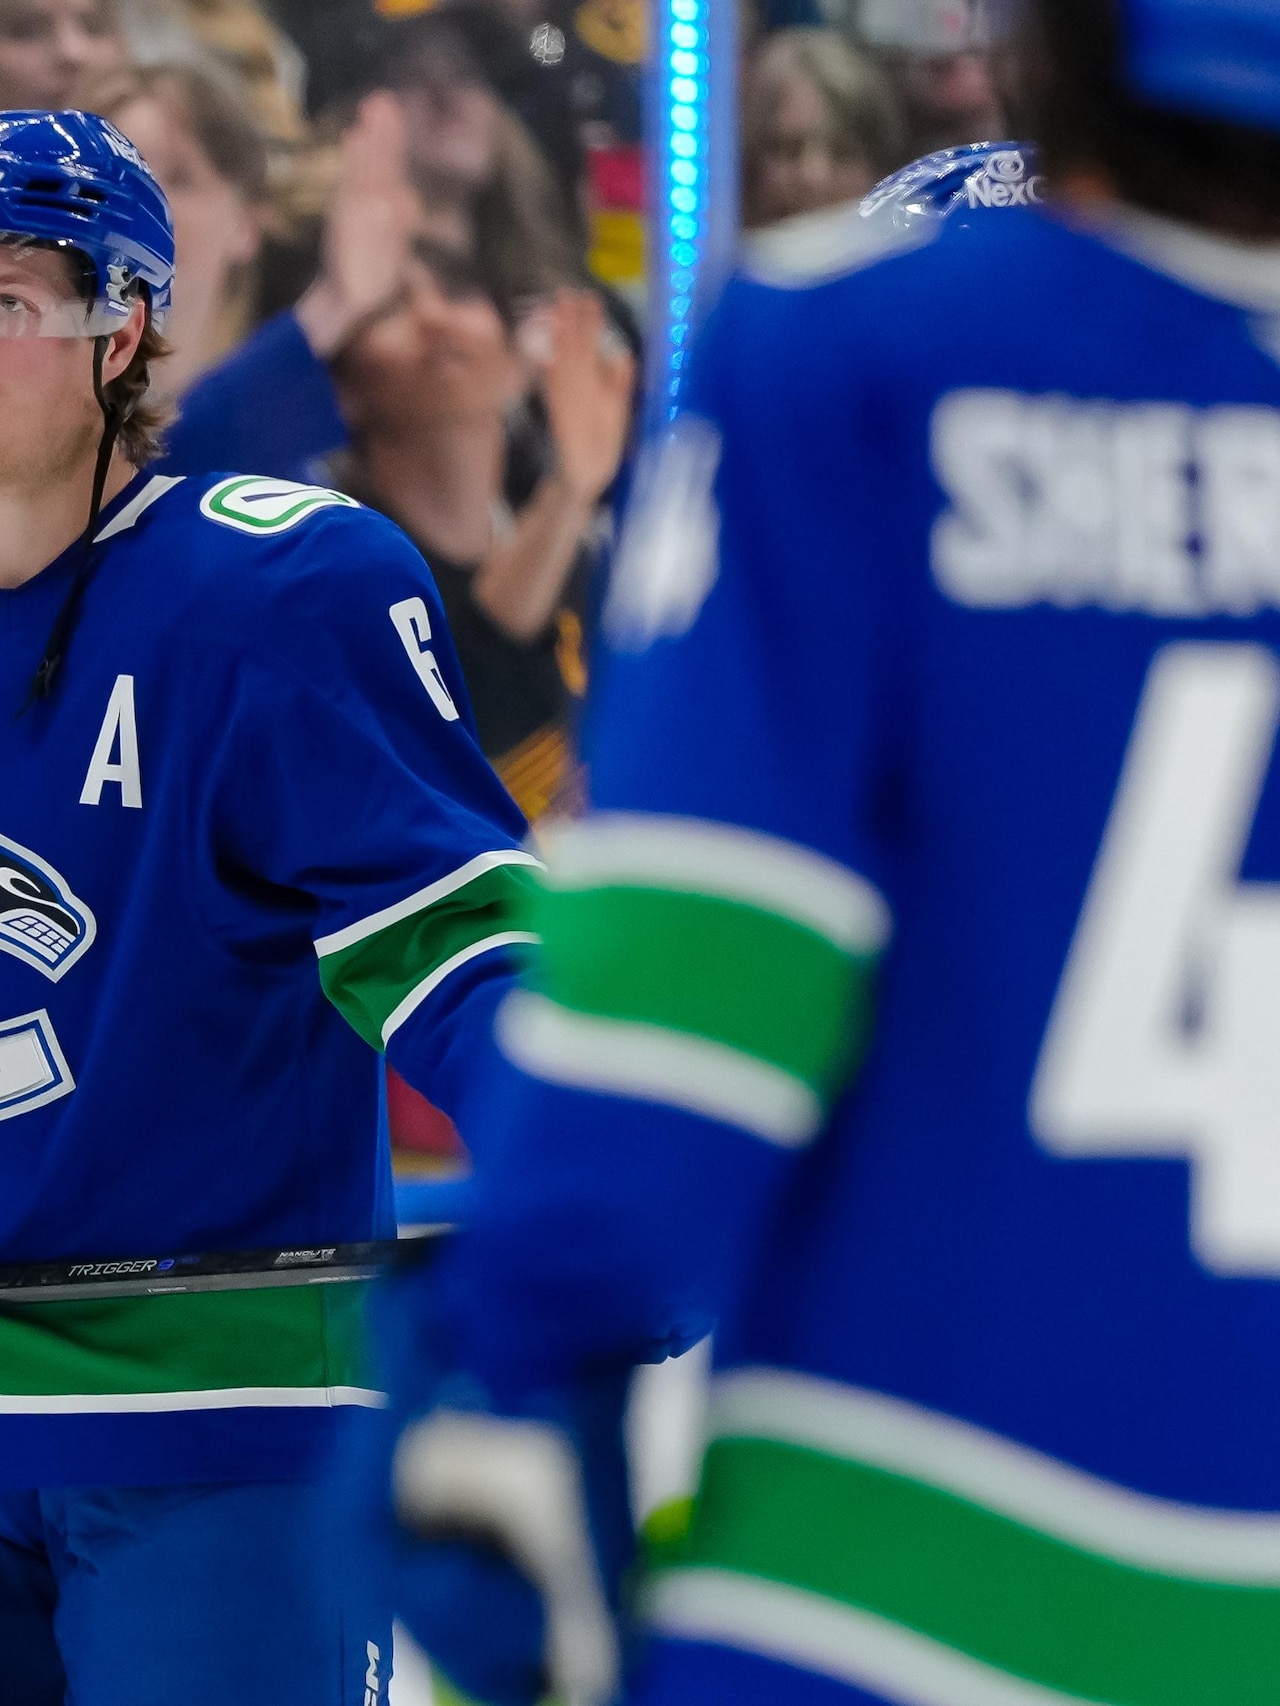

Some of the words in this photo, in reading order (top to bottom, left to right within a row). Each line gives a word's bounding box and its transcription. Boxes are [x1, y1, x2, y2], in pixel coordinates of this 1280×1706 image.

[389, 596, 460, 721] 6
[79, 674, 143, 809] A
[1026, 640, 1280, 1280] 4
[68, 1259, 157, 1276] TRIGGER
